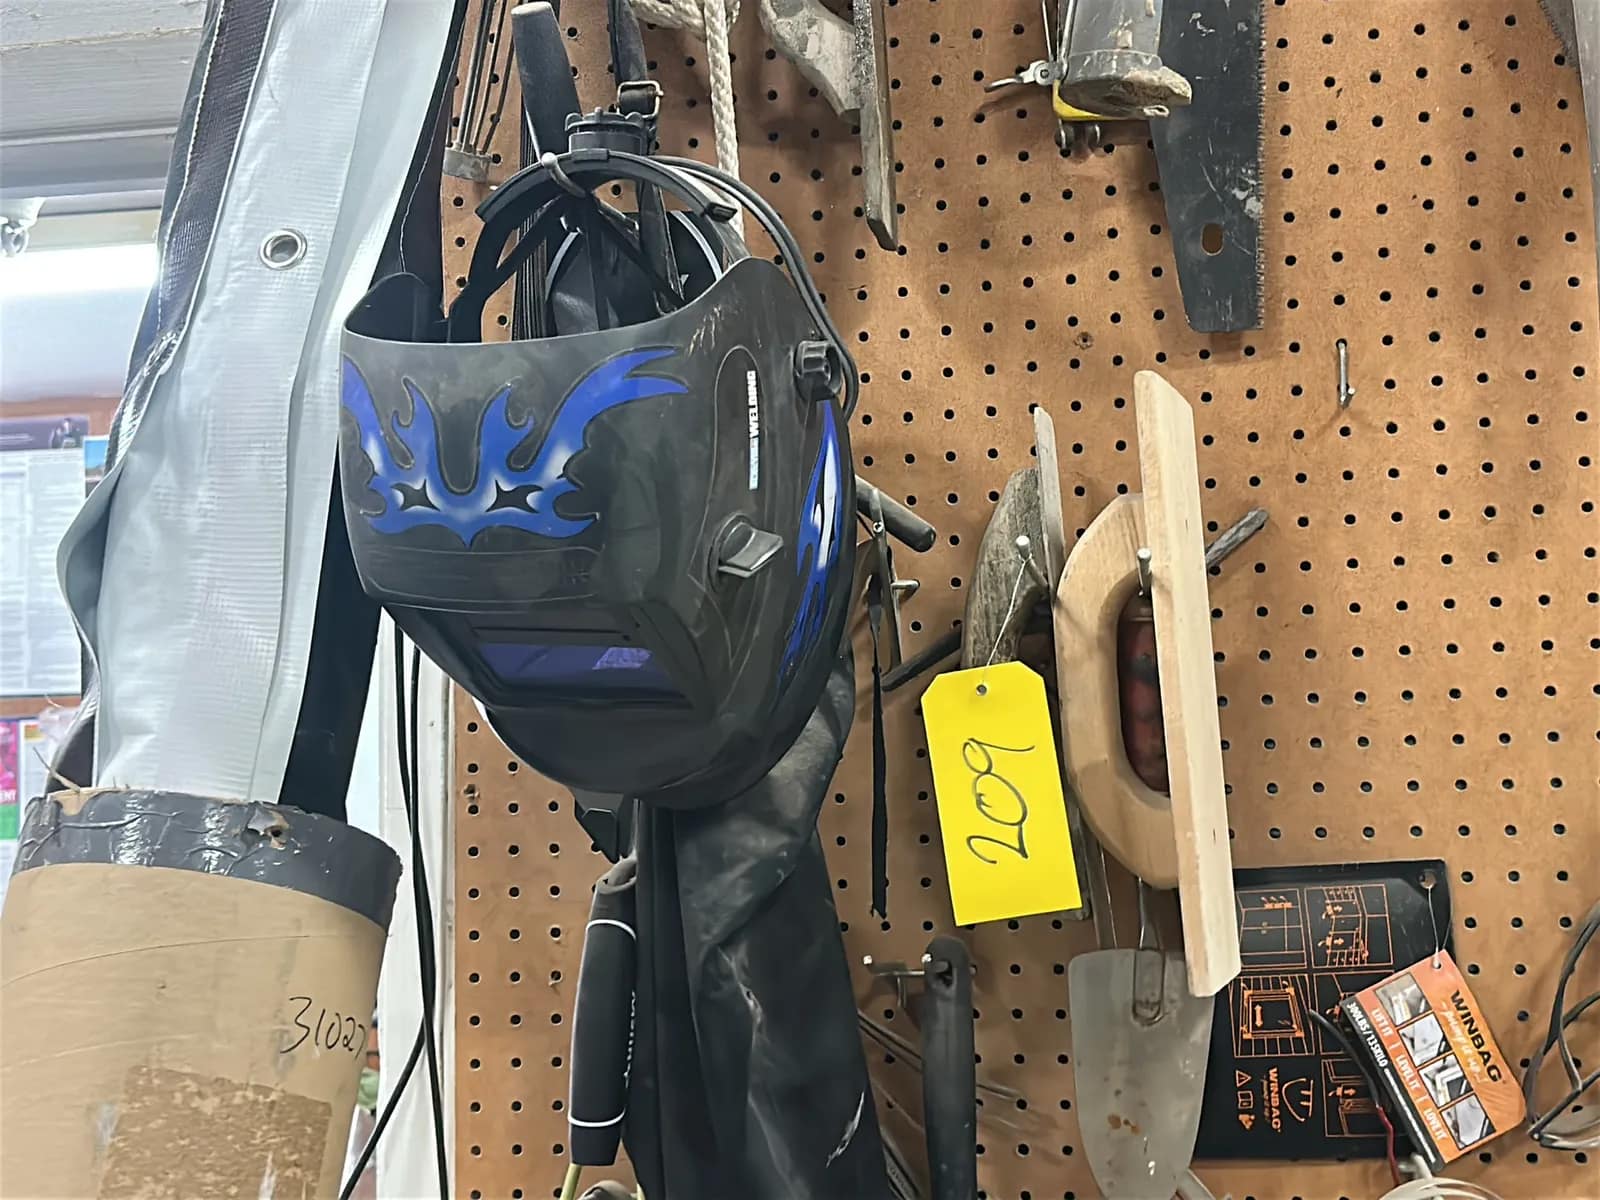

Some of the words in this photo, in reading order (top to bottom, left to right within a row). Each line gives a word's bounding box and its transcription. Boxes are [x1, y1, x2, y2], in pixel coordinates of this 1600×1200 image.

[747, 370, 759, 438] WELDING
[963, 738, 1035, 864] 209
[280, 996, 366, 1061] 31027
[1451, 989, 1502, 1082] WINBAG
[1269, 1067, 1280, 1129] WINBAG
